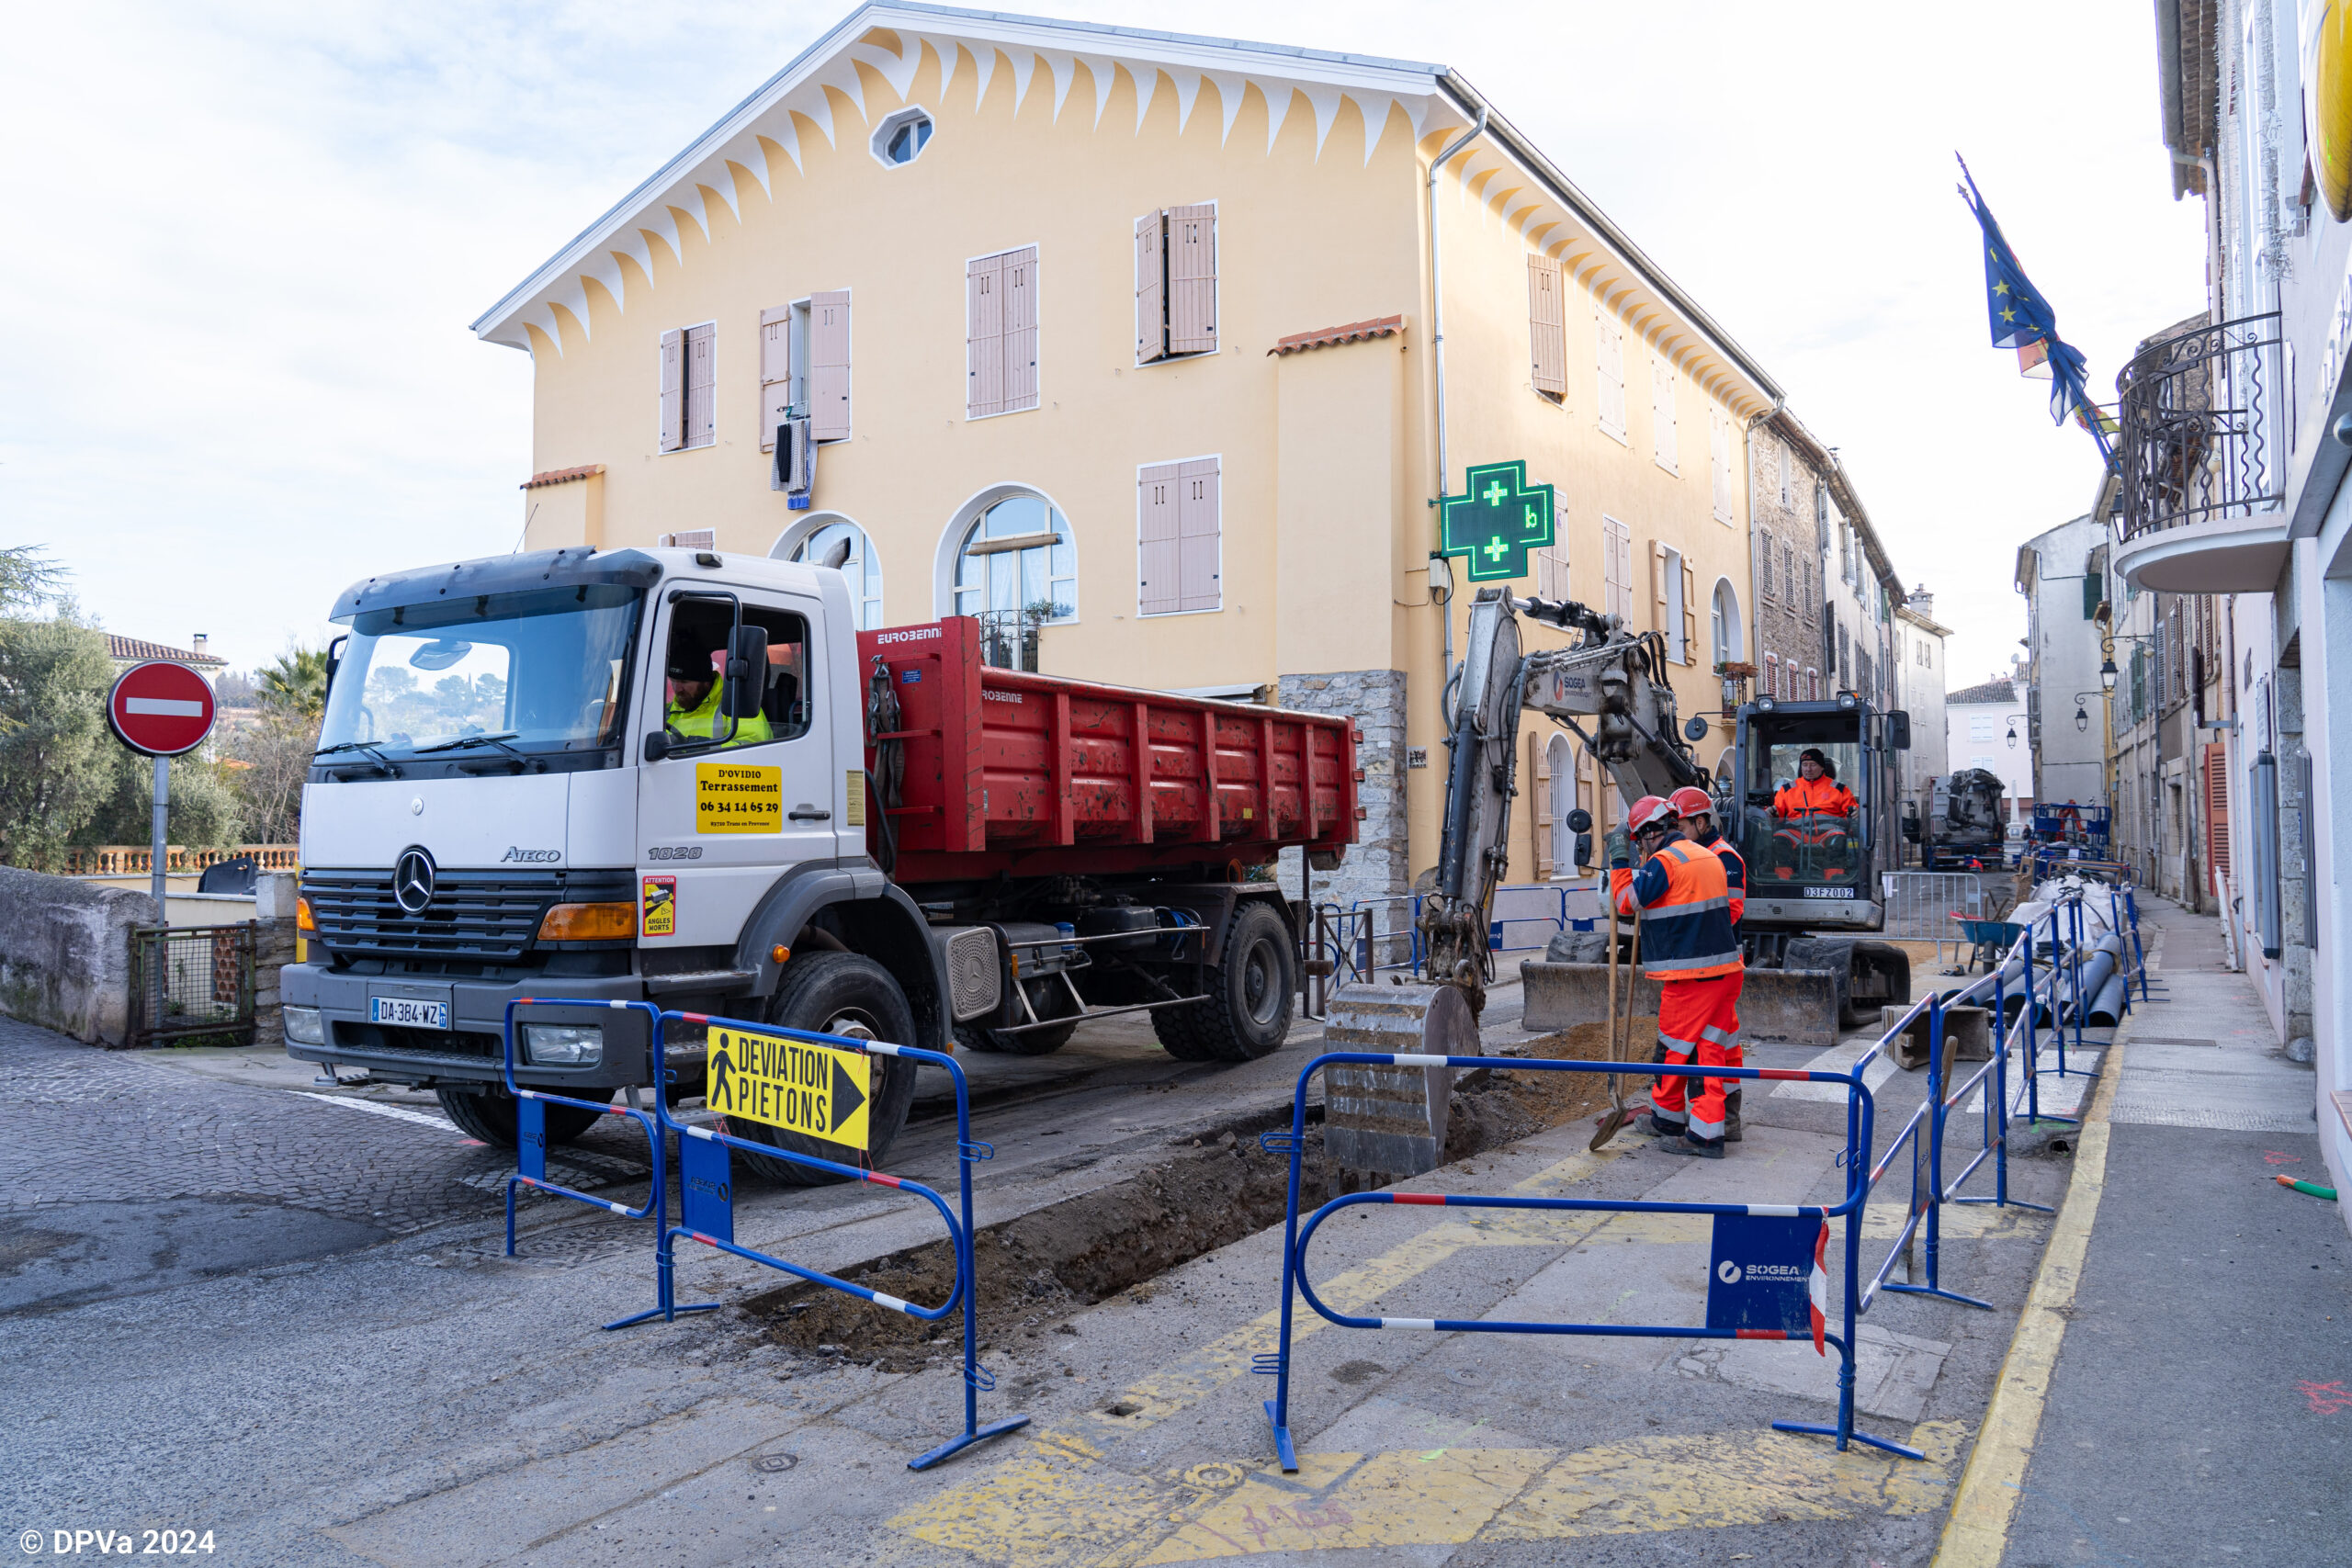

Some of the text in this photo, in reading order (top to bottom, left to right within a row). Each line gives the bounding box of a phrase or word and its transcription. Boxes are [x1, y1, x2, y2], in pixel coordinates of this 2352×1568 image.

[877, 626, 942, 645] EUROBENN
[1565, 676, 1586, 689] SOGEA
[981, 690, 1023, 704] ROBENNE
[718, 769, 762, 779] D'OVIDIO
[700, 781, 778, 793] Terrassement
[700, 802, 779, 814] 06 34 14 65 29
[648, 847, 703, 861] 1828
[1804, 887, 1853, 897] D3FZ002
[381, 1001, 437, 1024] DA-384-WZ
[739, 1036, 828, 1091] DEVIATION
[739, 1077, 827, 1133] PIETONS
[1746, 1264, 1800, 1276] SOGEA
